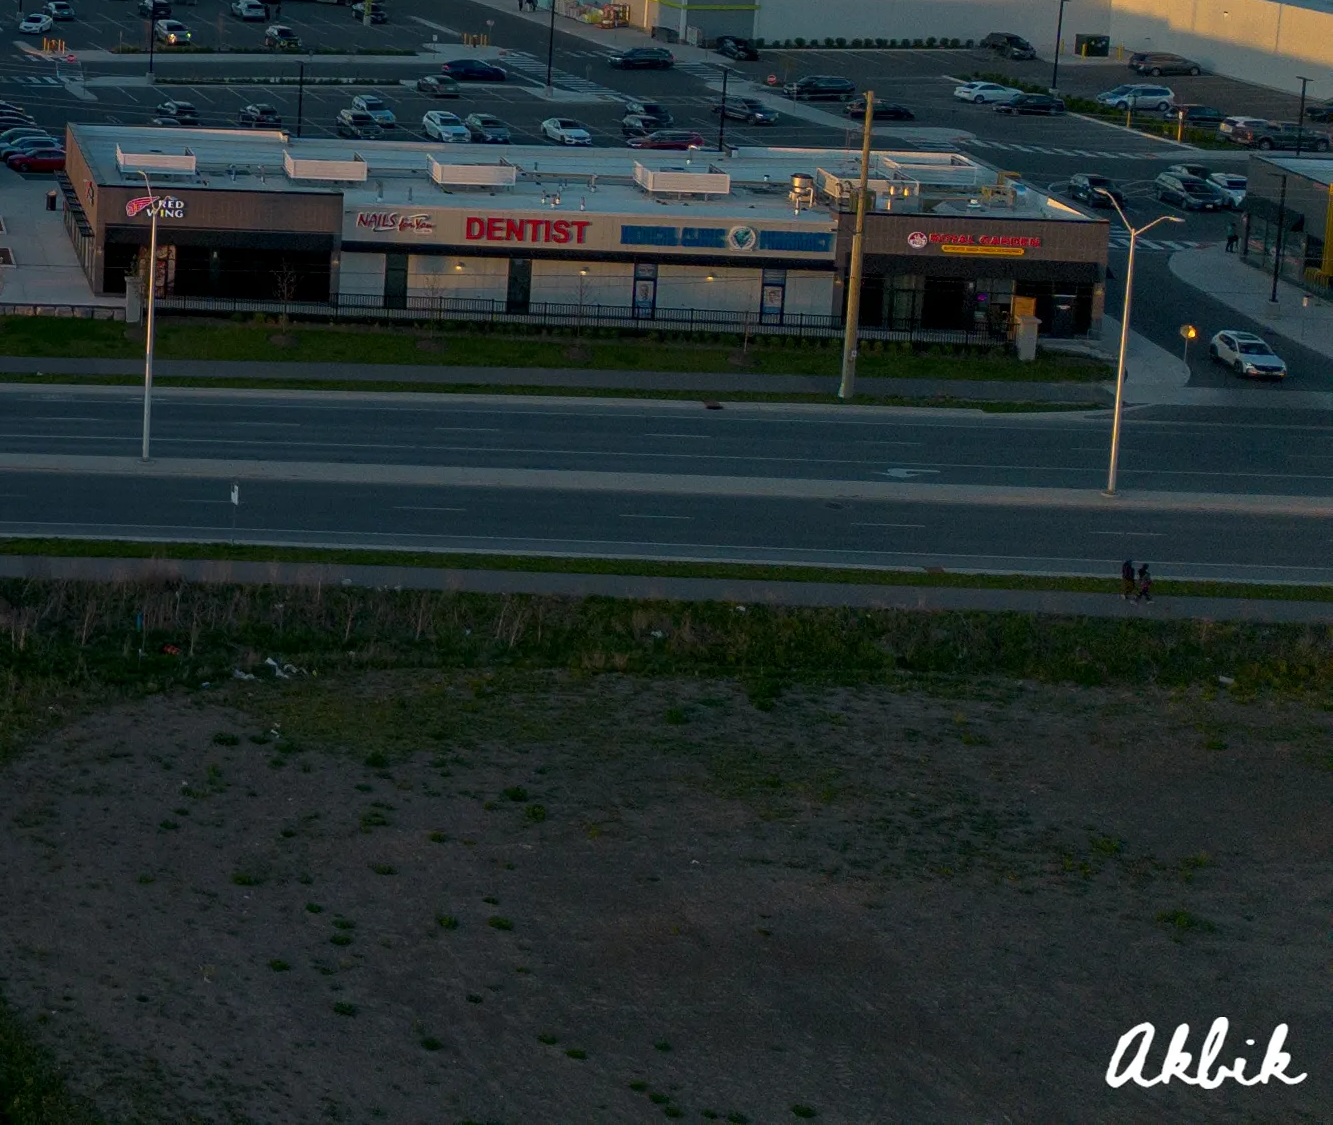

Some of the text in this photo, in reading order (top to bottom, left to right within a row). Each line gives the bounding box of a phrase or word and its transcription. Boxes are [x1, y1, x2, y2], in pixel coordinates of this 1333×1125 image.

[158, 200, 185, 209] RED
[147, 209, 184, 219] WING
[357, 213, 397, 232] NAILS
[465, 217, 590, 245] DENTIST
[929, 233, 1041, 248] ROYAL GARDEN
